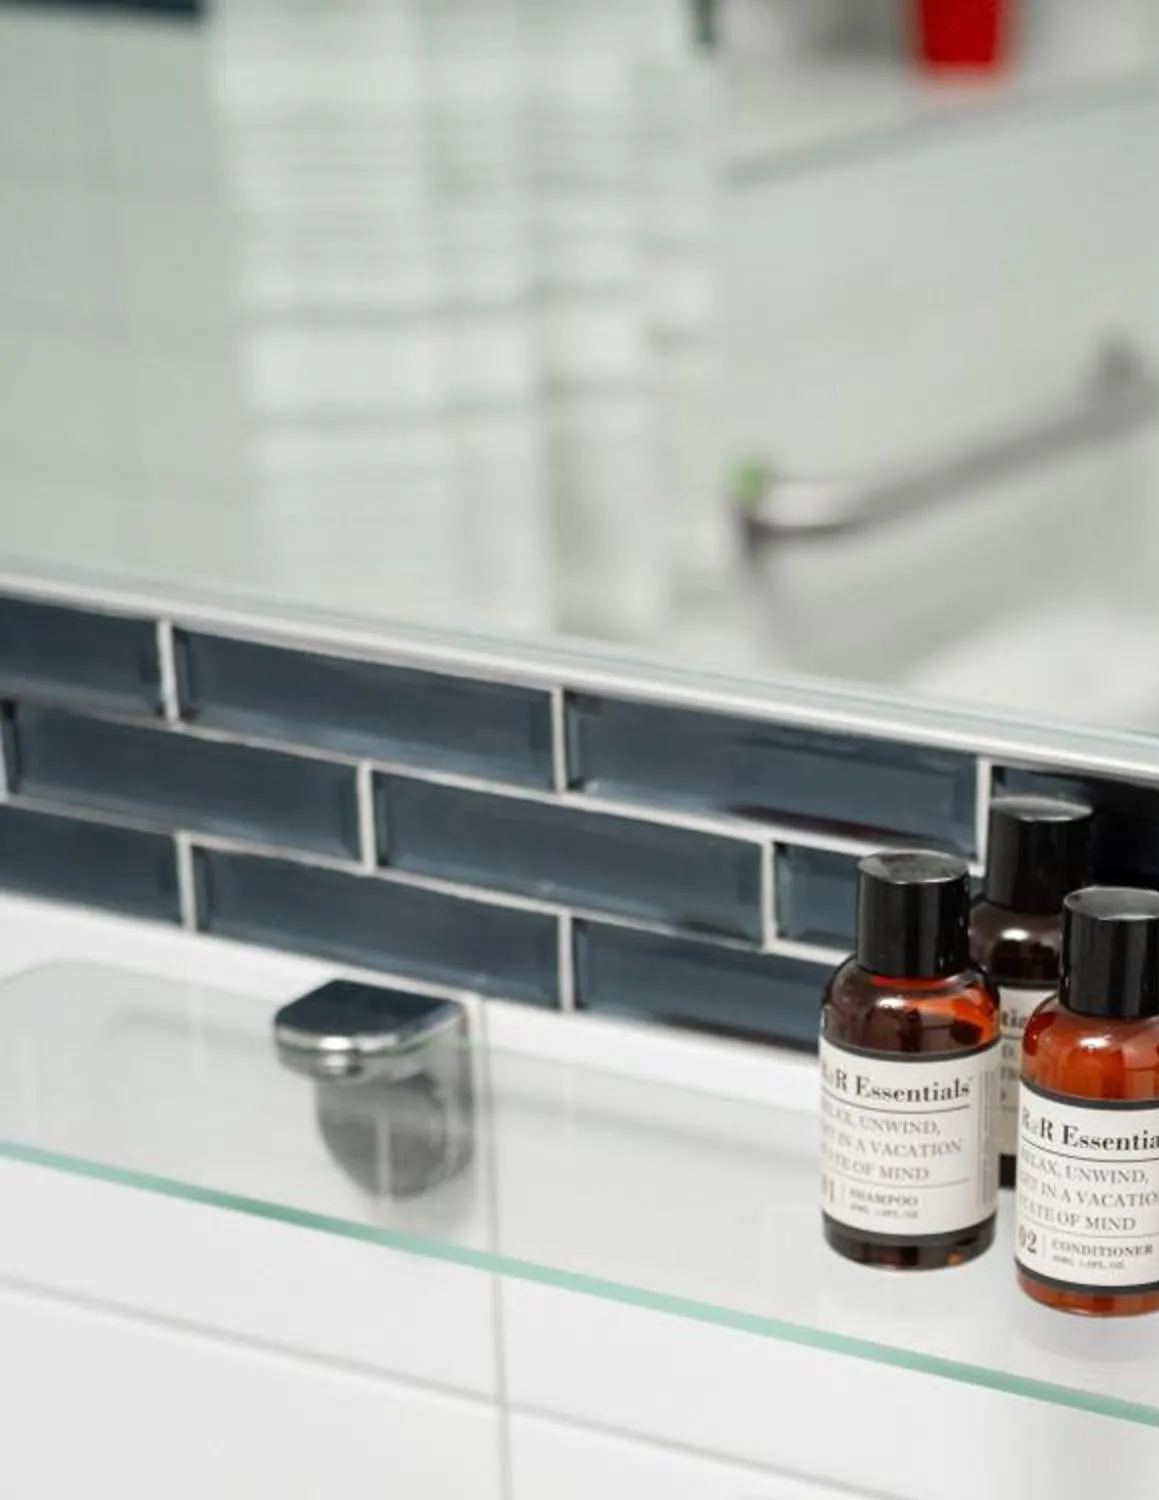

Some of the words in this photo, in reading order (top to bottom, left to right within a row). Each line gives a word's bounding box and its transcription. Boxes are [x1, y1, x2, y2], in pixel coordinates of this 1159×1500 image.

[856, 1075, 971, 1102] Essentials
[859, 1115, 942, 1136] UNWIND,
[870, 1139, 963, 1158] VACATION
[878, 1166, 930, 1181] MIND
[1066, 1165, 1149, 1185] UNWIND,
[1057, 1211, 1081, 1227] OF
[1085, 1216, 1136, 1232] MIND
[1051, 1239, 1153, 1257] CONDITIONER
